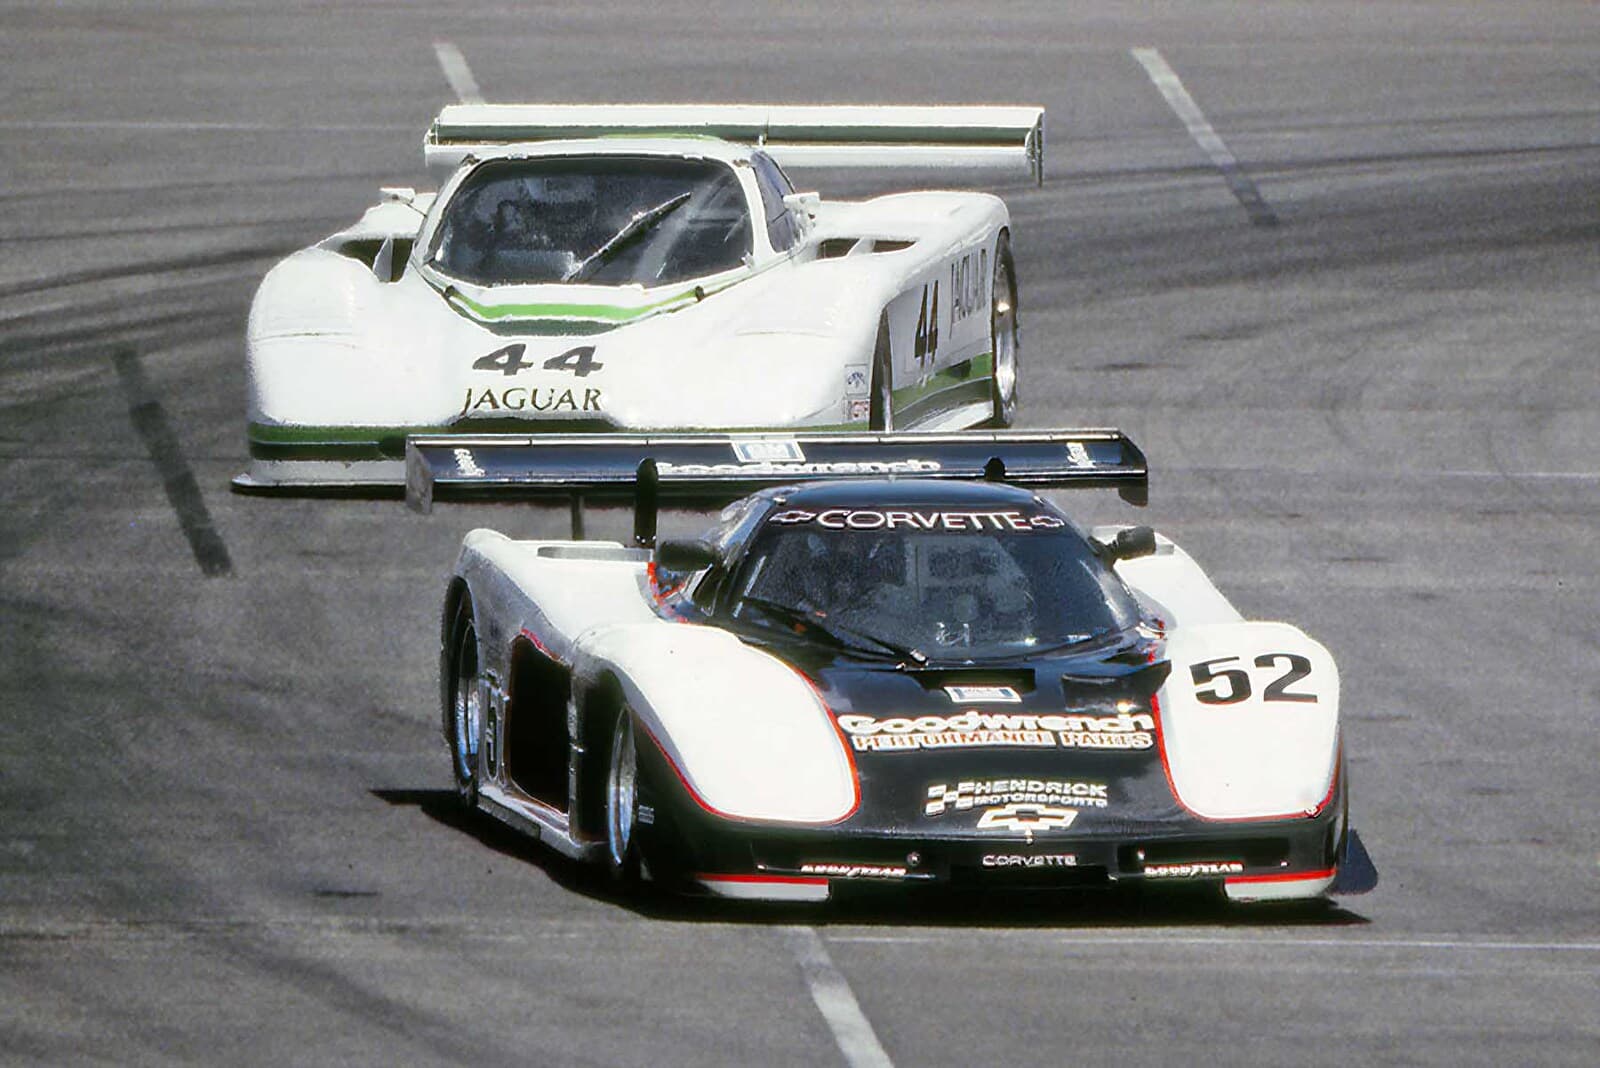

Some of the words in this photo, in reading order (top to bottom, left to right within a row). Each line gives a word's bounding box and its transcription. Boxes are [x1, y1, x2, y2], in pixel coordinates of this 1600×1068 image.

[914, 279, 938, 368] 44
[472, 343, 604, 377] 44
[460, 387, 602, 416] JAGUAR
[816, 509, 1033, 530] CORVETTE
[1189, 653, 1318, 706] 52
[837, 710, 1155, 735] Goodwrench
[851, 730, 1056, 751] PERFORMANCE
[1059, 731, 1154, 750] PARTS
[973, 779, 1108, 798] HENDRICK
[972, 792, 1108, 809] MOTORSPORTS
[981, 854, 1078, 867] CORVETTE
